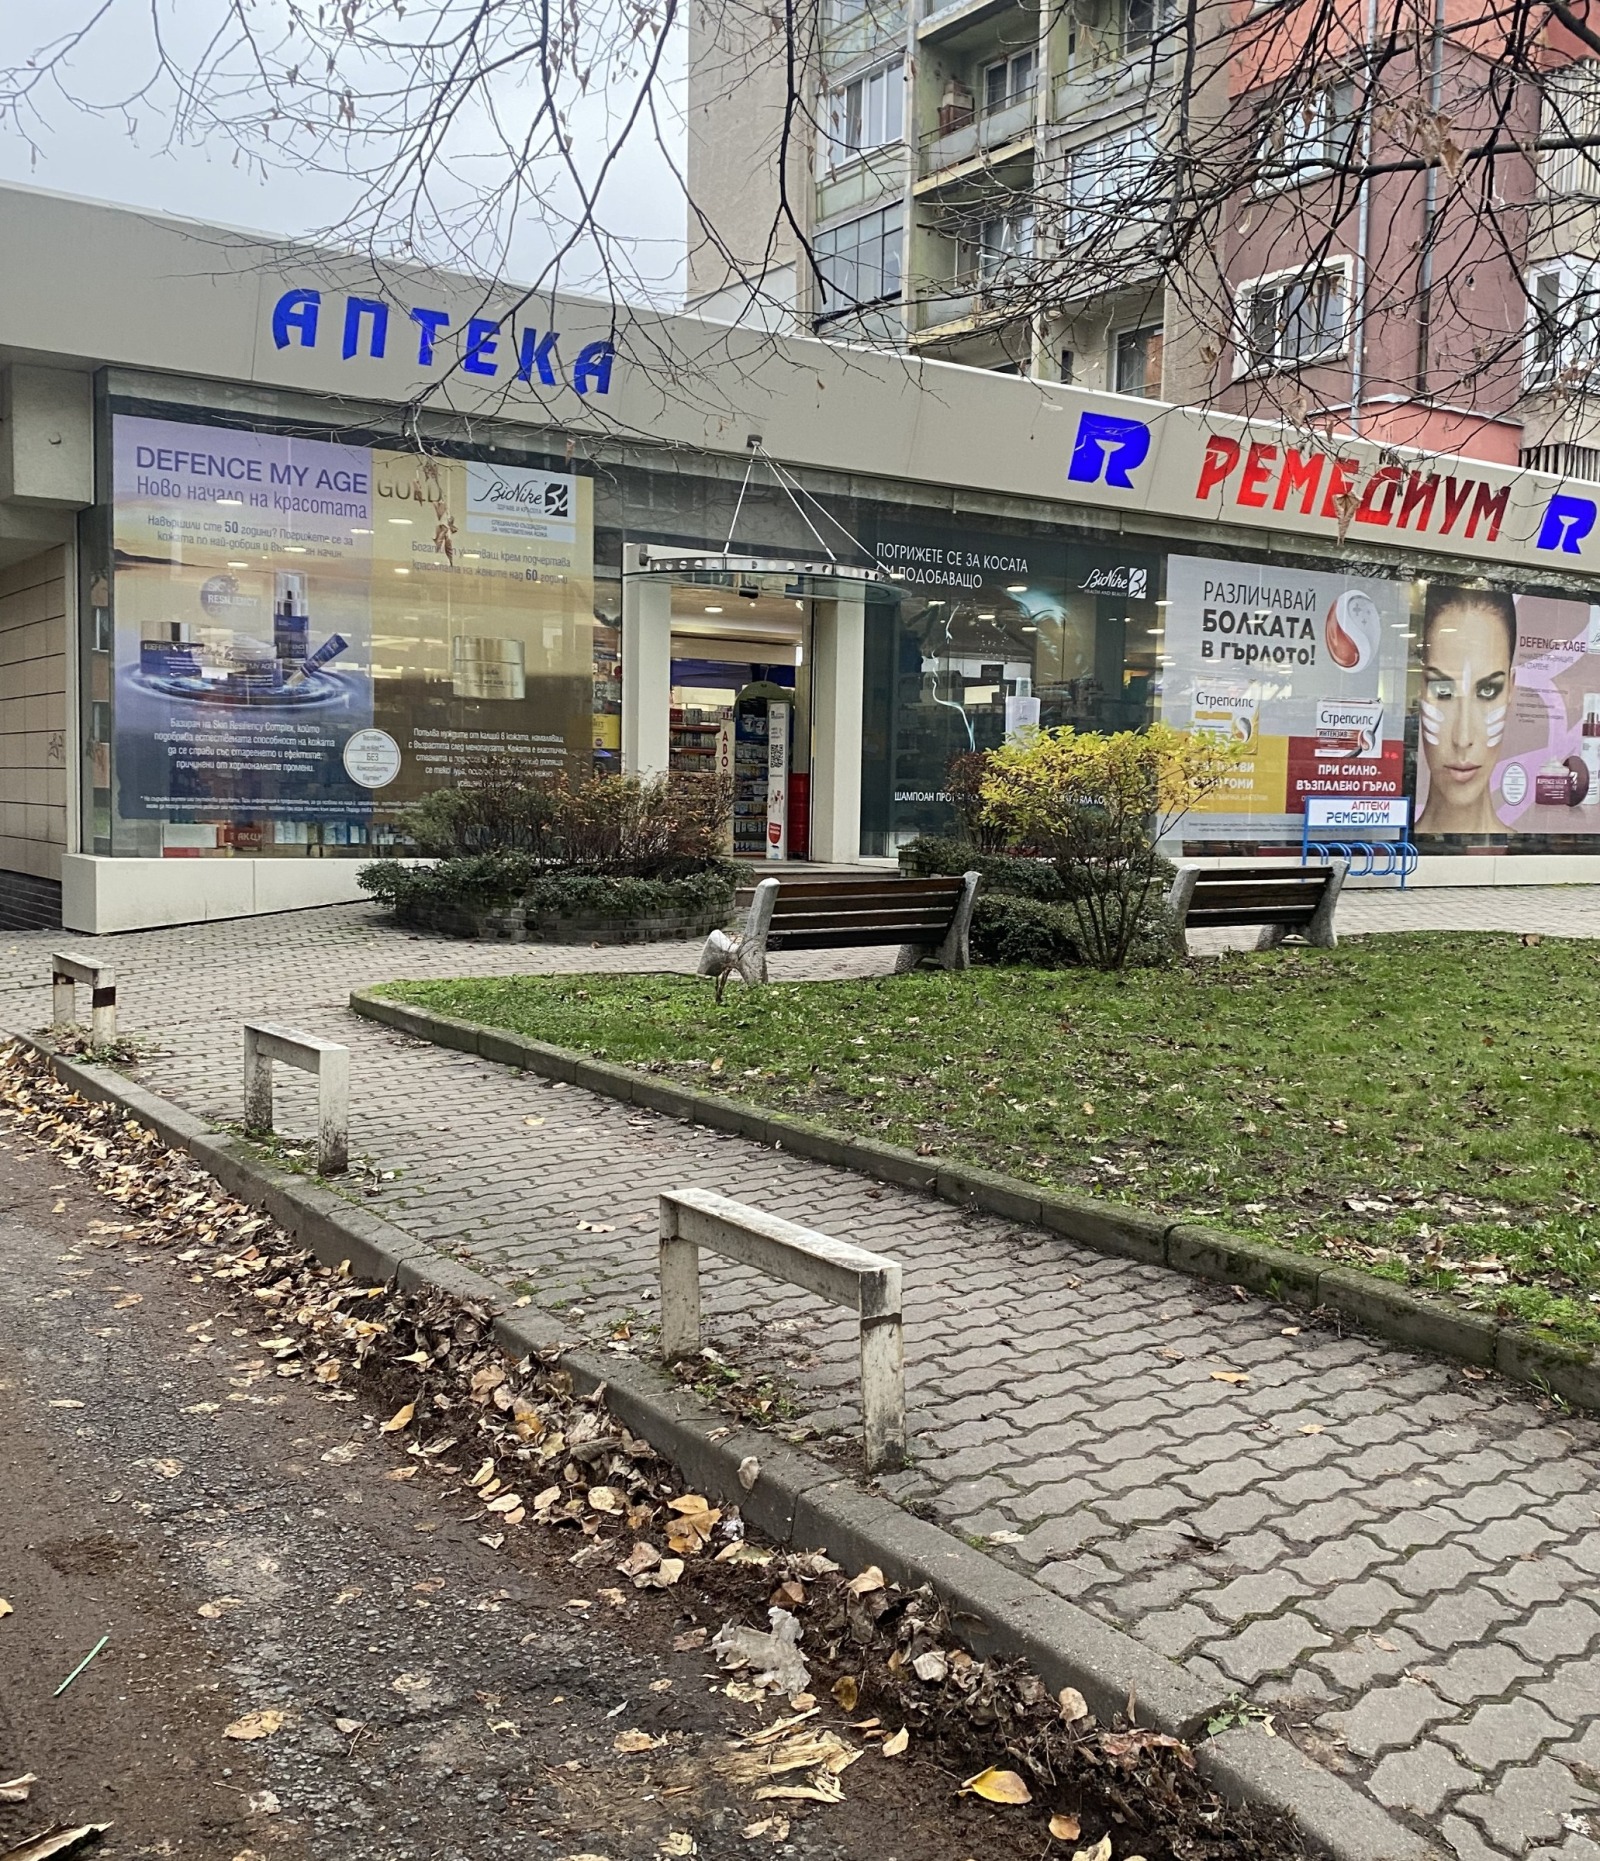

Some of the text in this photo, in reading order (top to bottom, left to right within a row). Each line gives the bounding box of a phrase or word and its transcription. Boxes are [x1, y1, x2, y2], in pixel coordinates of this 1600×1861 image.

[272, 288, 616, 396] АПТЕКА
[136, 446, 368, 495] DEFENCE MY AGE
[137, 475, 367, 519] Ново начало на красотата
[473, 480, 543, 503] BioNike
[1196, 434, 1512, 542] РЕМЕДИУМ
[148, 515, 200, 530] Навършили
[203, 521, 222, 532] сте
[224, 520, 239, 534] 50
[241, 526, 277, 538] години?
[331, 536, 342, 545] се
[343, 537, 354, 546] за
[196, 536, 208, 545] по
[210, 537, 260, 551] най-добрия
[263, 542, 268, 551] и
[501, 550, 521, 563] крем
[876, 542, 1028, 573] ПОГРИЖЕТЕ СЕ ЗА КОСАТА
[525, 568, 538, 581] 60
[898, 566, 982, 589] ПОДОБАВАЩО
[1077, 566, 1128, 589] BioNike
[1203, 580, 1316, 612] РАЗЛИЧАВАЙ
[1202, 608, 1315, 641] БОЛКАТА
[1221, 641, 1316, 666] гърлото!
[1520, 636, 1560, 650] DEFENCE
[1196, 691, 1254, 709] Стрепсилс
[1321, 710, 1374, 727] Стрепсилс
[1318, 764, 1339, 775] ПРИ
[894, 791, 934, 801] ШАМПОАН
[1296, 780, 1396, 792] ВЪЗПАЛЕНО ГЪРЛО
[1351, 801, 1390, 811] АПТЕКИ
[1326, 812, 1390, 824] РЕМЕДИУМ
